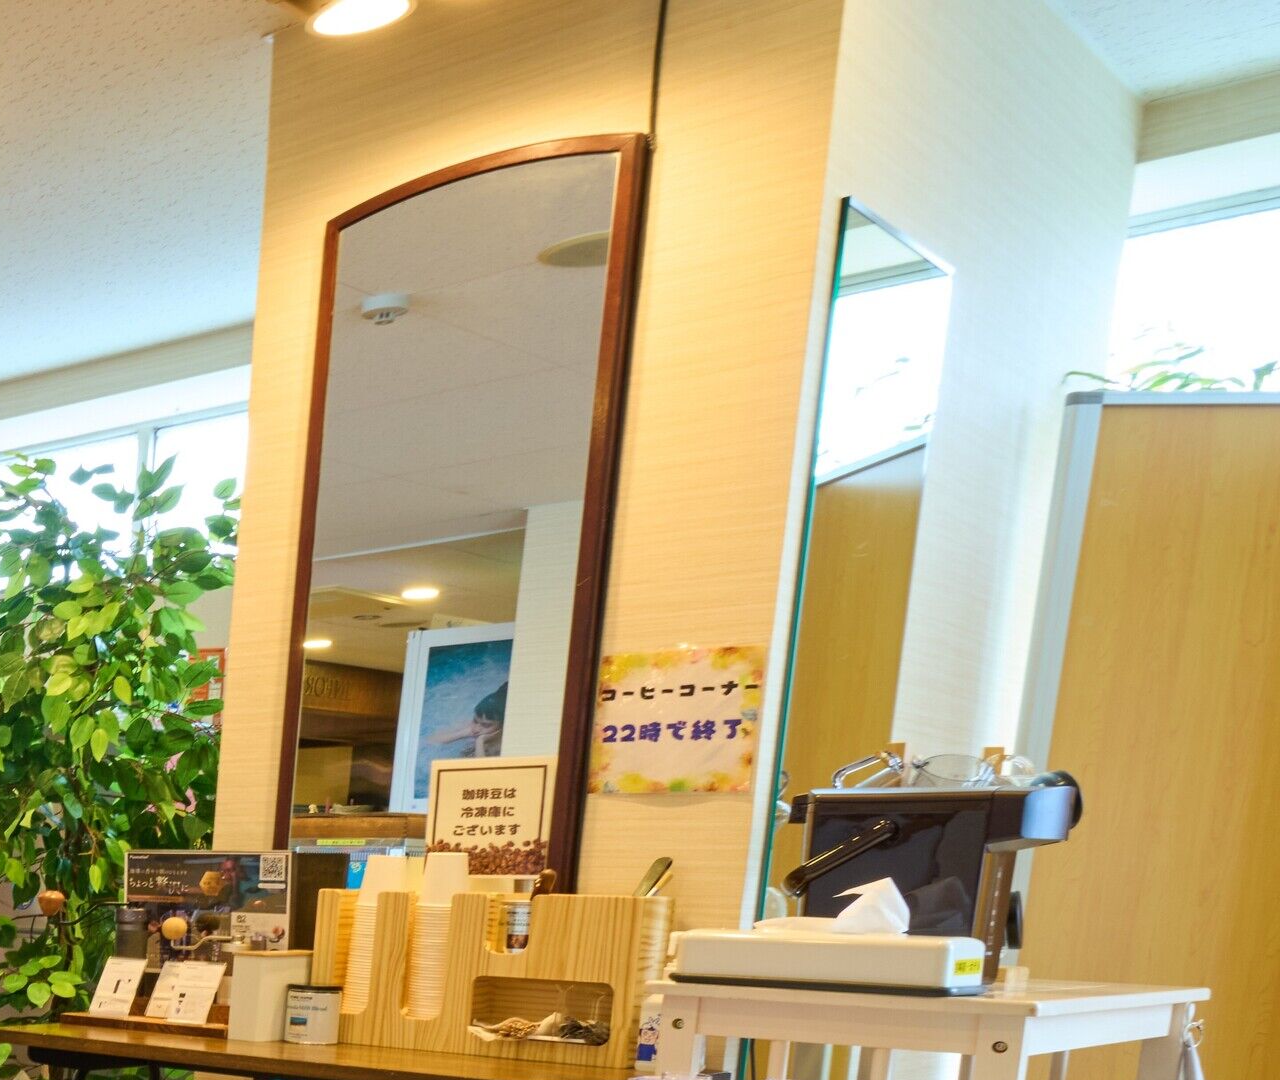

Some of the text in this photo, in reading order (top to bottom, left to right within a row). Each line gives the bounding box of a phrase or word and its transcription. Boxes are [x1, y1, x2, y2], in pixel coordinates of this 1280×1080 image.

[602, 680, 759, 702] コーヒーコーナー
[602, 718, 742, 743] 22時で終了
[462, 787, 517, 801] 珈琲豆は
[460, 804, 515, 818] 冷凍庫に
[452, 823, 521, 837] ございます
